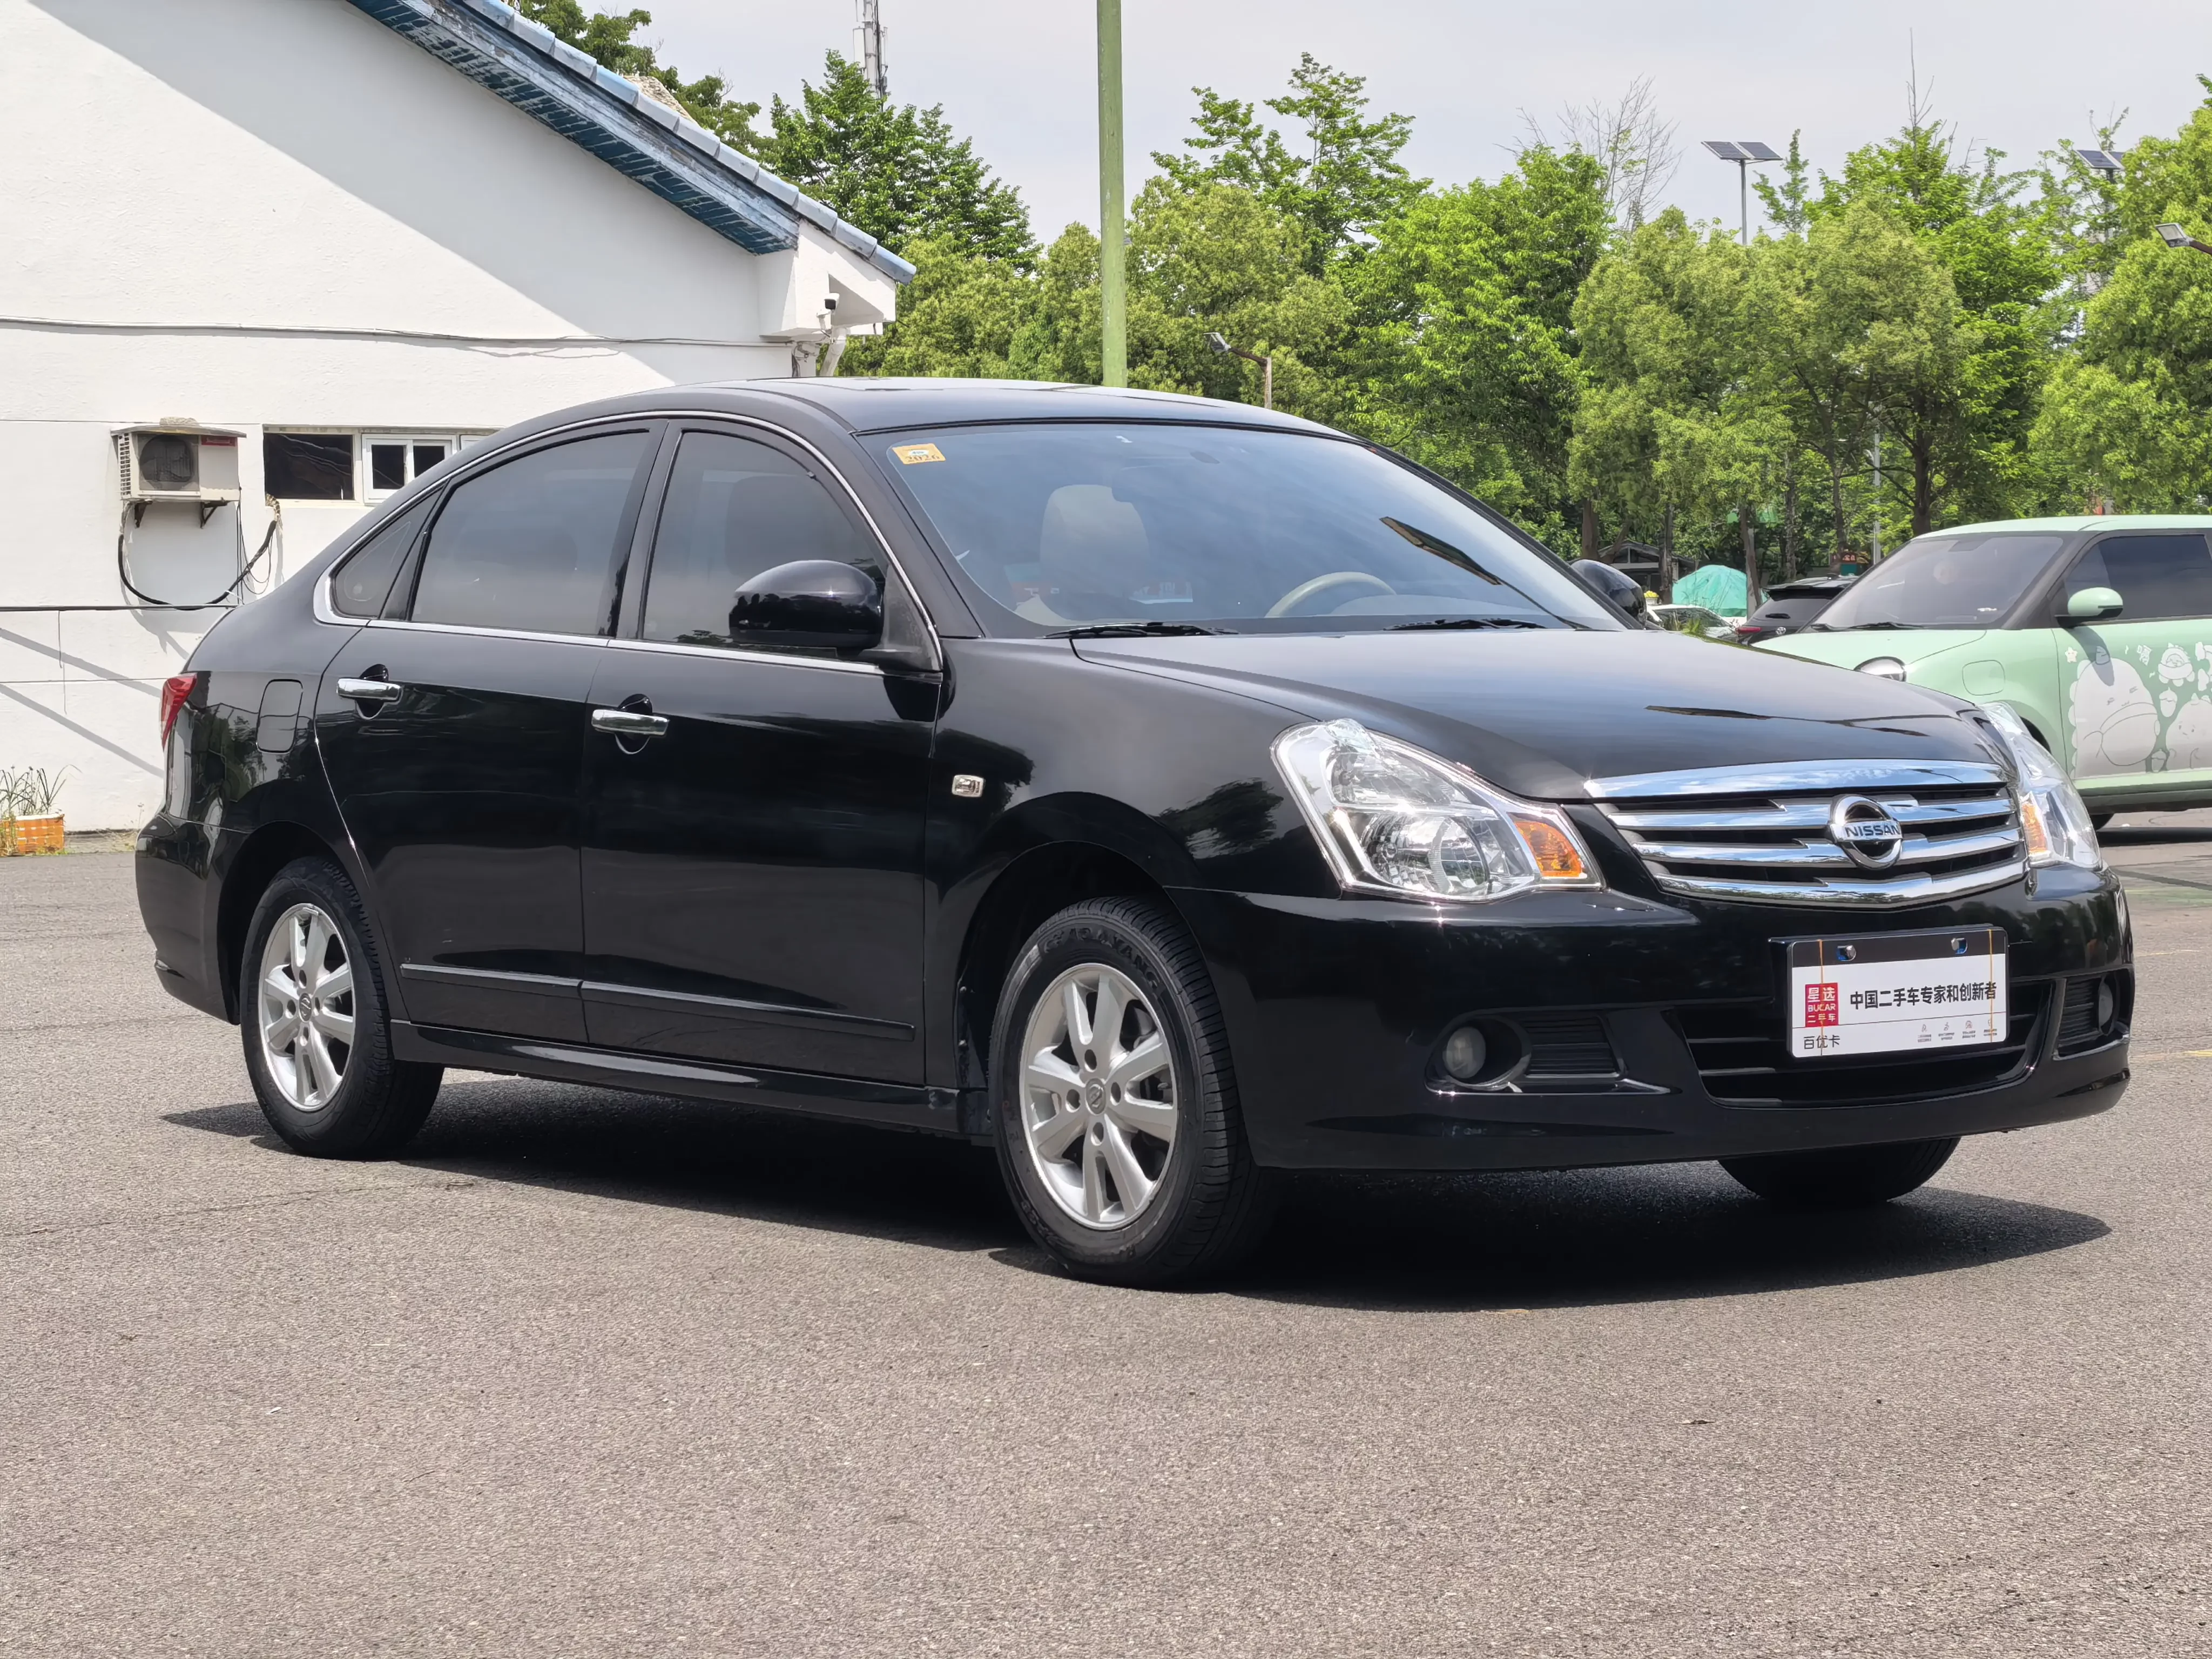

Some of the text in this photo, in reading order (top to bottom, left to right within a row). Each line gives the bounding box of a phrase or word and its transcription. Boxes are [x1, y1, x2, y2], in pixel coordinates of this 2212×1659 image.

[1845, 825, 1900, 837] NISSAN
[1808, 987, 1836, 1002] 星选
[1850, 981, 1997, 1009] 中国二手车专家和创新者
[1808, 1003, 1836, 1012] BUCAR
[1808, 1013, 1836, 1023] 二手车
[1804, 1034, 1840, 1049] 百优卡
